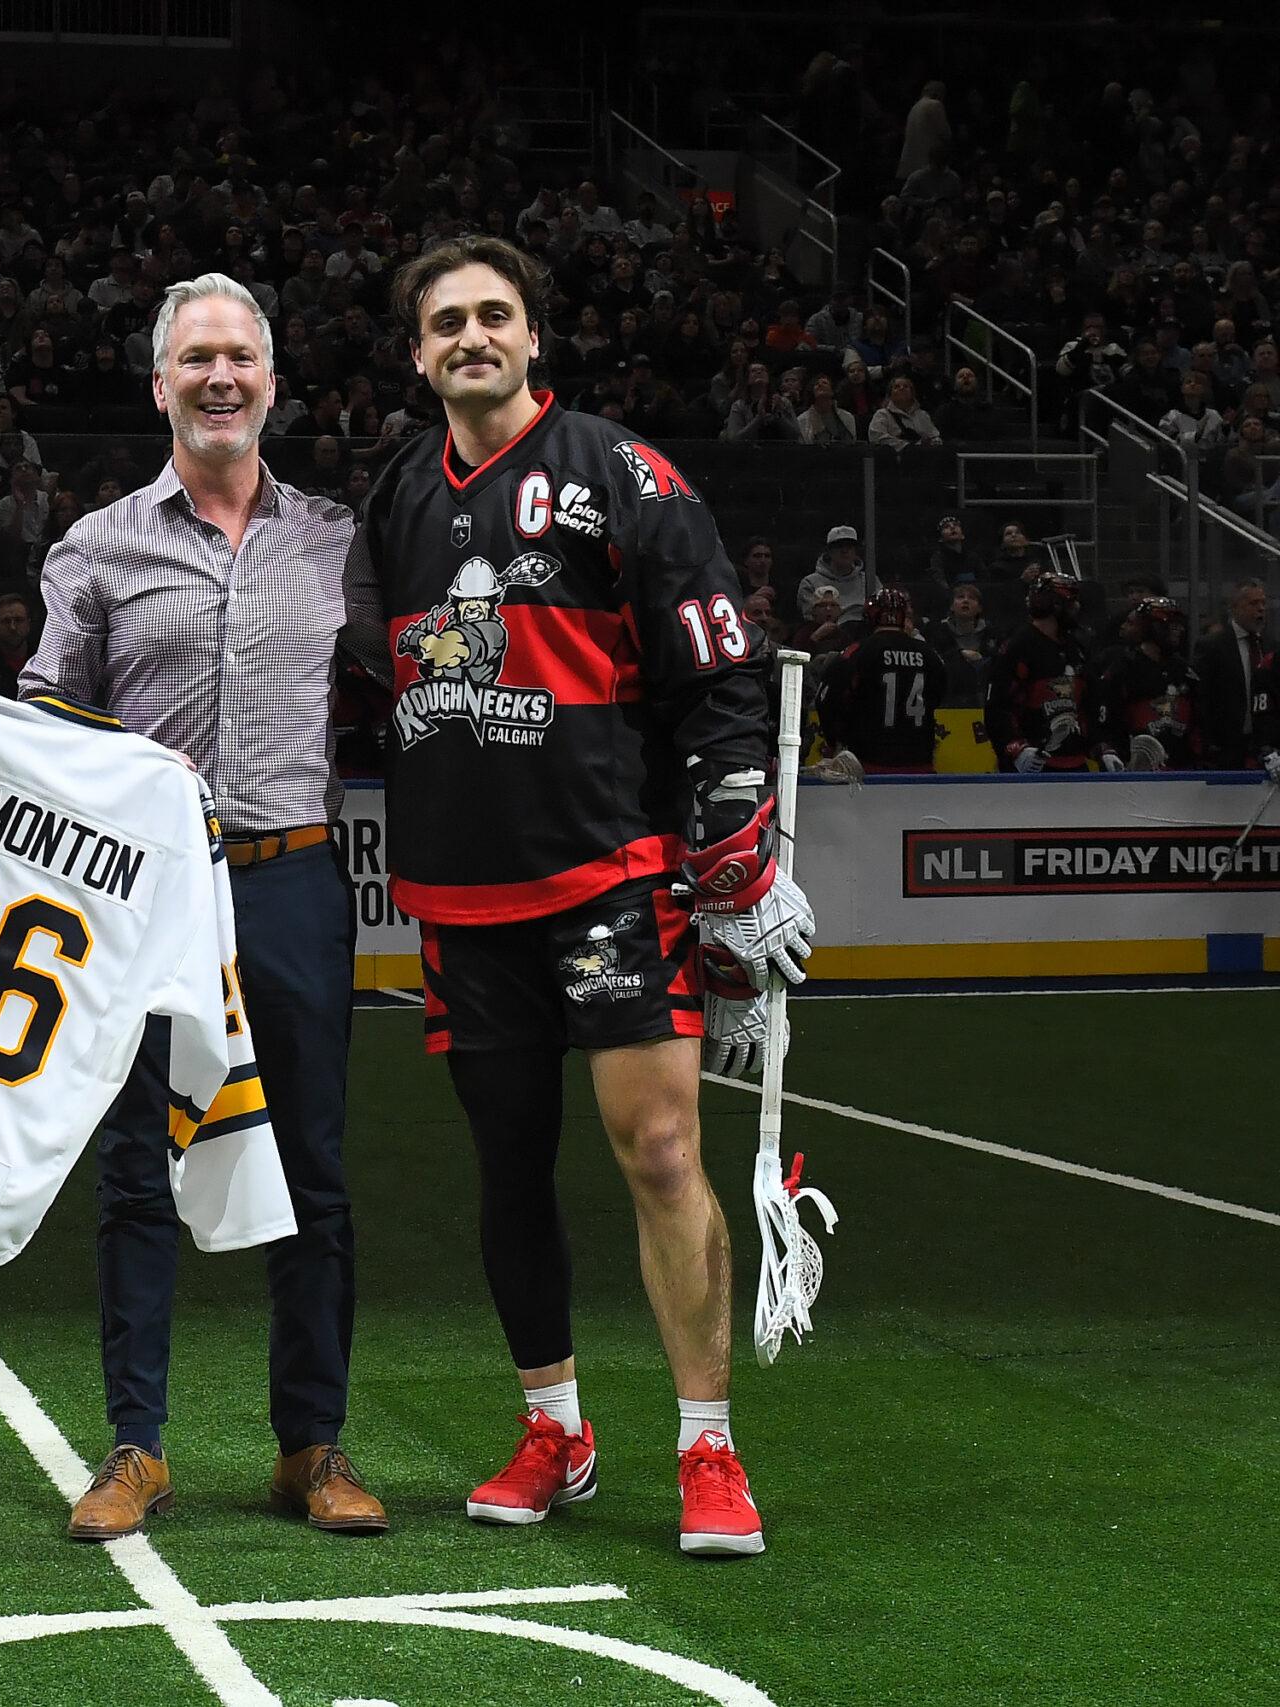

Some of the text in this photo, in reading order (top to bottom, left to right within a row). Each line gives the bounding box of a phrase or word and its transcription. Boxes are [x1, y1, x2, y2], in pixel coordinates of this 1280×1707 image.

[515, 471, 554, 539] C
[569, 502, 608, 526] play
[453, 516, 469, 527] NLL
[677, 593, 750, 669] 13
[883, 650, 924, 668] SYKES
[396, 676, 548, 743] ROUGHNECKS
[882, 672, 926, 727] 14
[488, 726, 545, 746] CALGARY
[923, 848, 1003, 880] NLL
[1024, 846, 1159, 876] FRIDAY
[566, 973, 641, 1002] ROUGHNECKS
[616, 990, 642, 999] CALGARY
